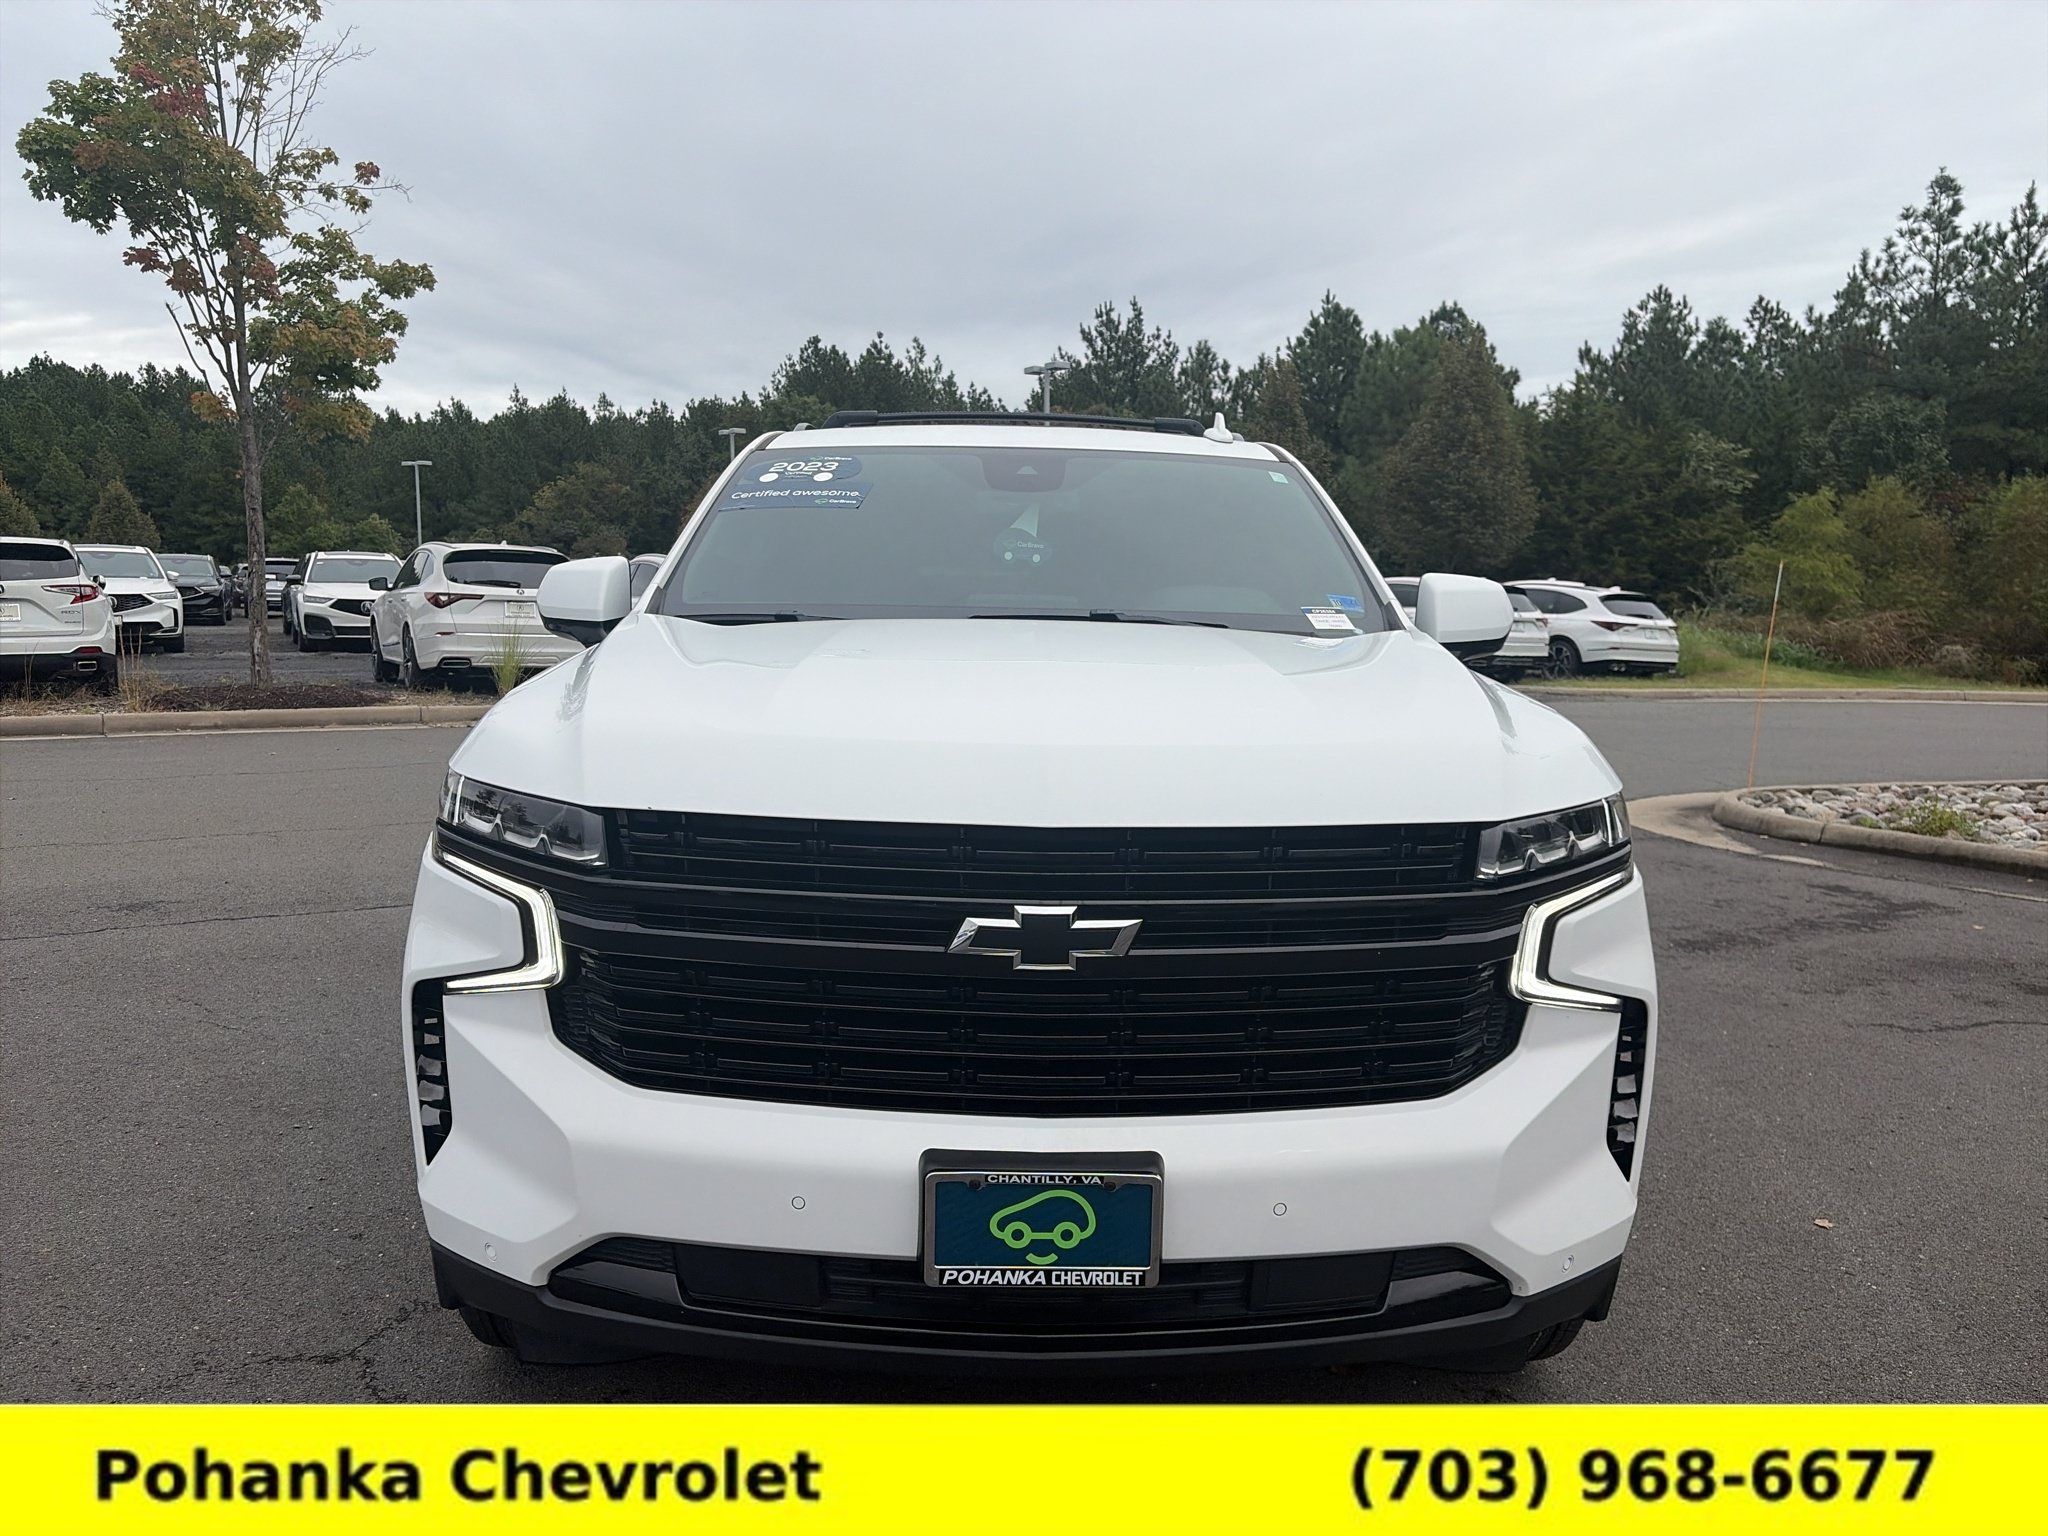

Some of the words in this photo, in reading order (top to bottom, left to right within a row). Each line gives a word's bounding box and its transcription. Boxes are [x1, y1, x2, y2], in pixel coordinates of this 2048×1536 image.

[768, 461, 839, 472] 2023
[731, 489, 790, 499] Certified
[987, 1174, 1077, 1185] CHANTILLY,
[1081, 1175, 1102, 1185] VA
[942, 1269, 1046, 1286] POHANKA
[1051, 1271, 1143, 1286] CHEVROLET
